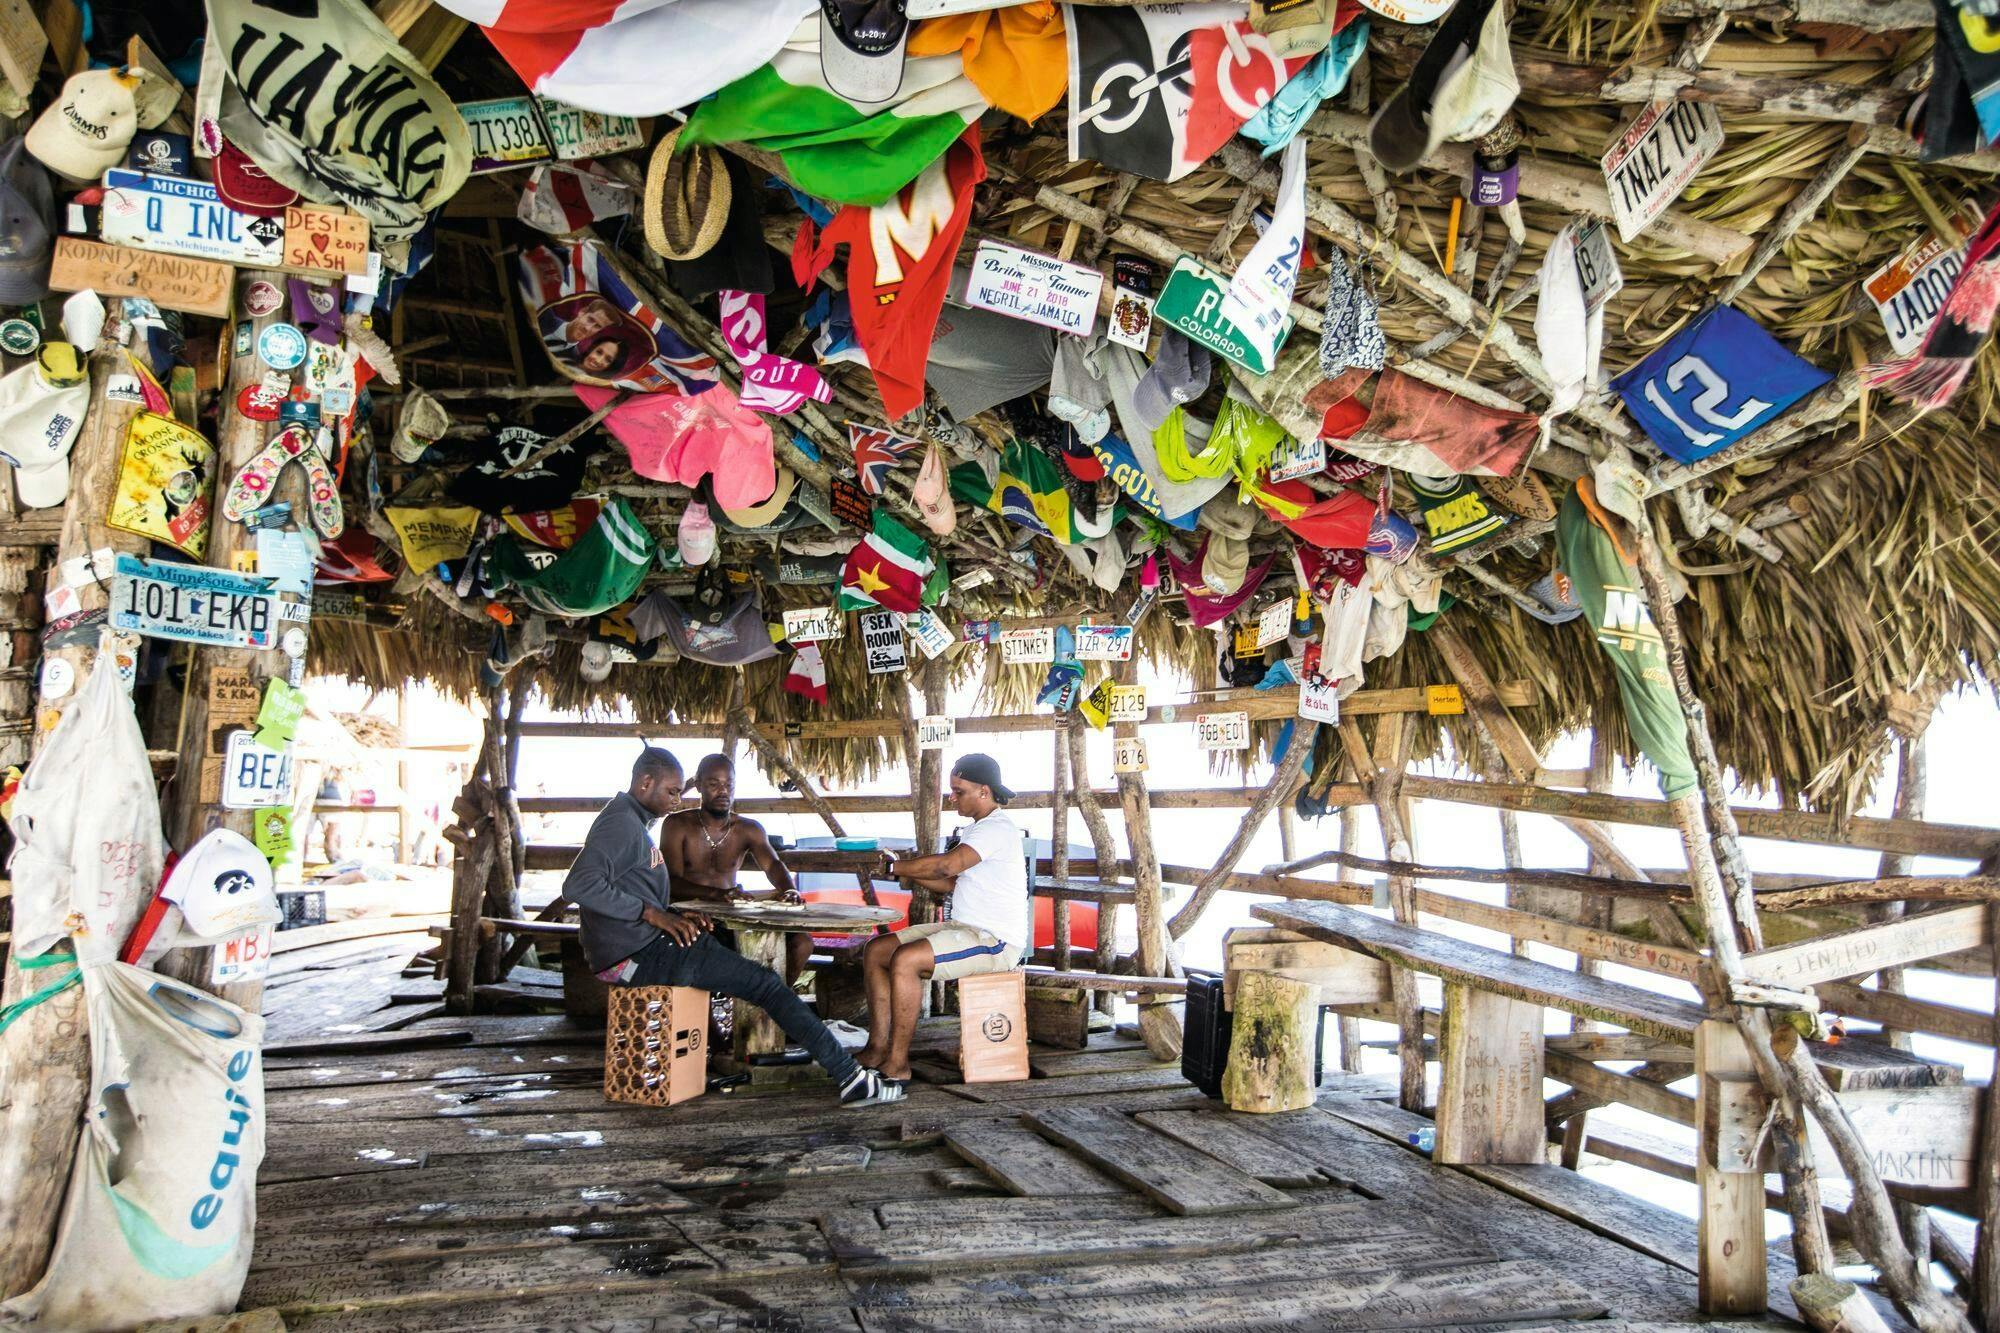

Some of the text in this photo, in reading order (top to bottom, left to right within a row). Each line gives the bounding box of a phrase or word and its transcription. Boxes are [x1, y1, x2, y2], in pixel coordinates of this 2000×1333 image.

[469, 115, 547, 157] ZT3381
[147, 197, 244, 244] Q INC
[287, 208, 339, 233] DESI
[336, 239, 365, 253] 2017
[290, 248, 346, 272] SASH
[1020, 253, 1064, 273] Missouri
[1000, 280, 1069, 307] JUNE 21 2018
[1032, 302, 1082, 328] JAMAICA
[1179, 315, 1246, 359] COLORADO
[1644, 355, 1773, 450] 12
[48, 416, 73, 450] SPORTS
[49, 413, 65, 431] CBS
[133, 432, 186, 460] CROSSING
[134, 425, 173, 448] MOOSE
[1424, 491, 1489, 537] PACKERS
[125, 578, 184, 623] 101
[209, 590, 269, 634] EKB
[117, 614, 139, 628] DEC
[162, 625, 195, 637] 10,000
[869, 612, 894, 631] SEX
[866, 630, 902, 649] ROOM
[1005, 638, 1049, 655] STINKEY
[1107, 636, 1130, 652] 297
[231, 689, 256, 700] KIM
[238, 752, 292, 790] BEA
